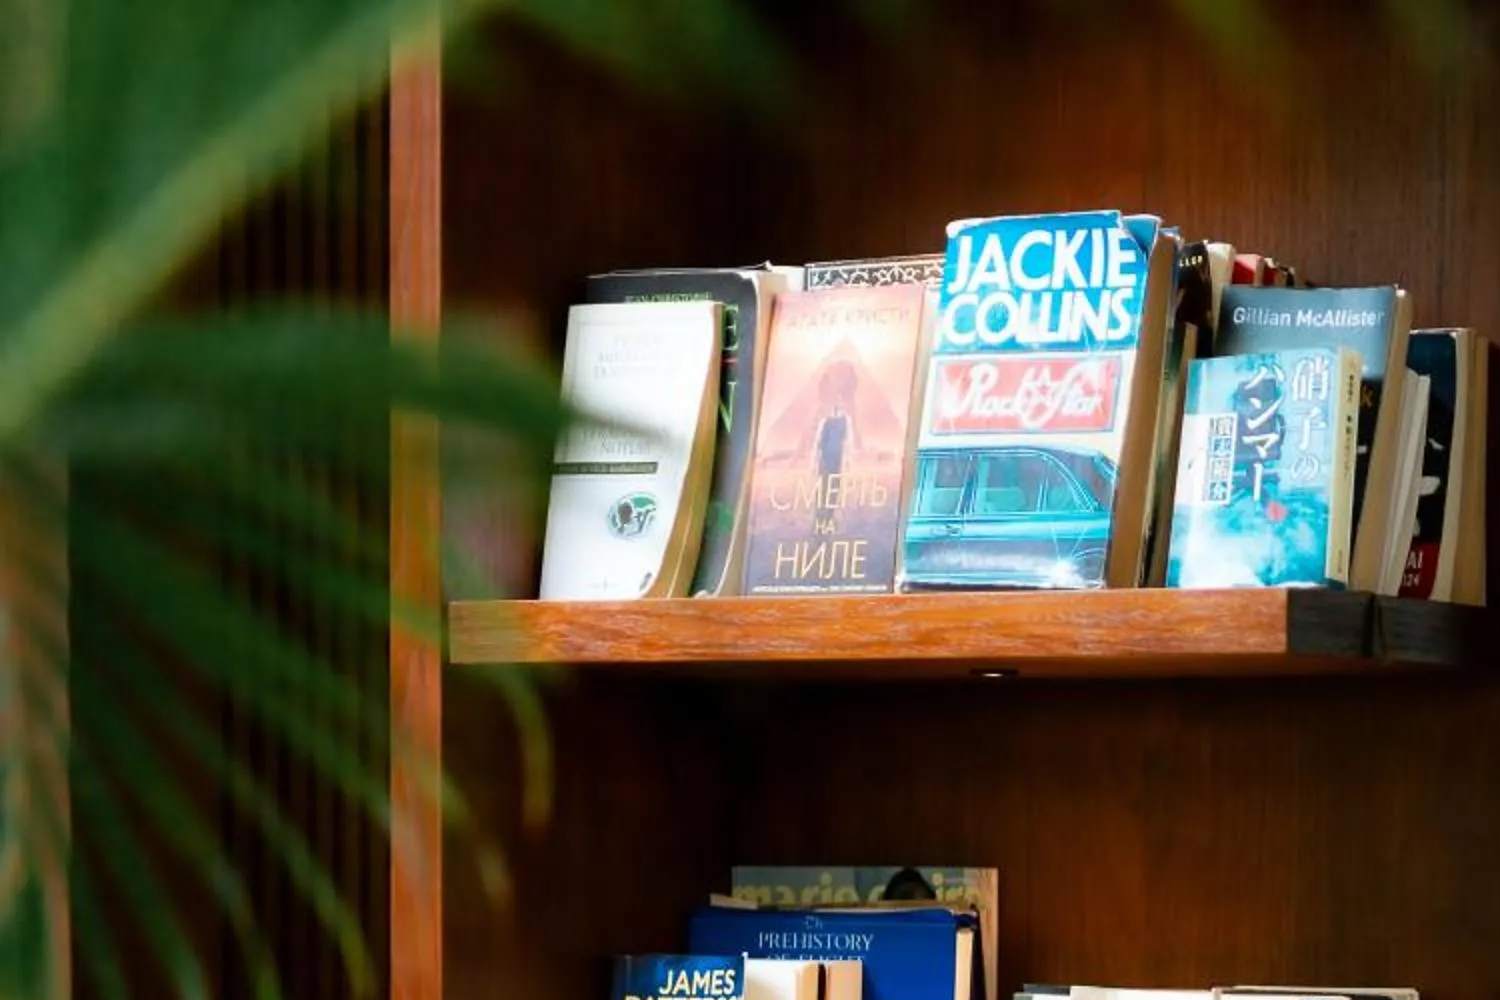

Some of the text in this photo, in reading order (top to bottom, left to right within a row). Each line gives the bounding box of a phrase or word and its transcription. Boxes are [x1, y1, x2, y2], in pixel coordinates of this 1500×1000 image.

[948, 228, 1137, 293] JACKIE
[943, 287, 1134, 344] COLLINS
[1233, 306, 1384, 328] Gillian McAllister
[1242, 365, 1285, 502] ハンマー
[769, 473, 888, 511] СМЕРТЬ
[815, 518, 837, 534] НА
[774, 541, 868, 579] НИЛЕ
[759, 931, 874, 952] PREHISTORY
[659, 969, 736, 996] JAMES
